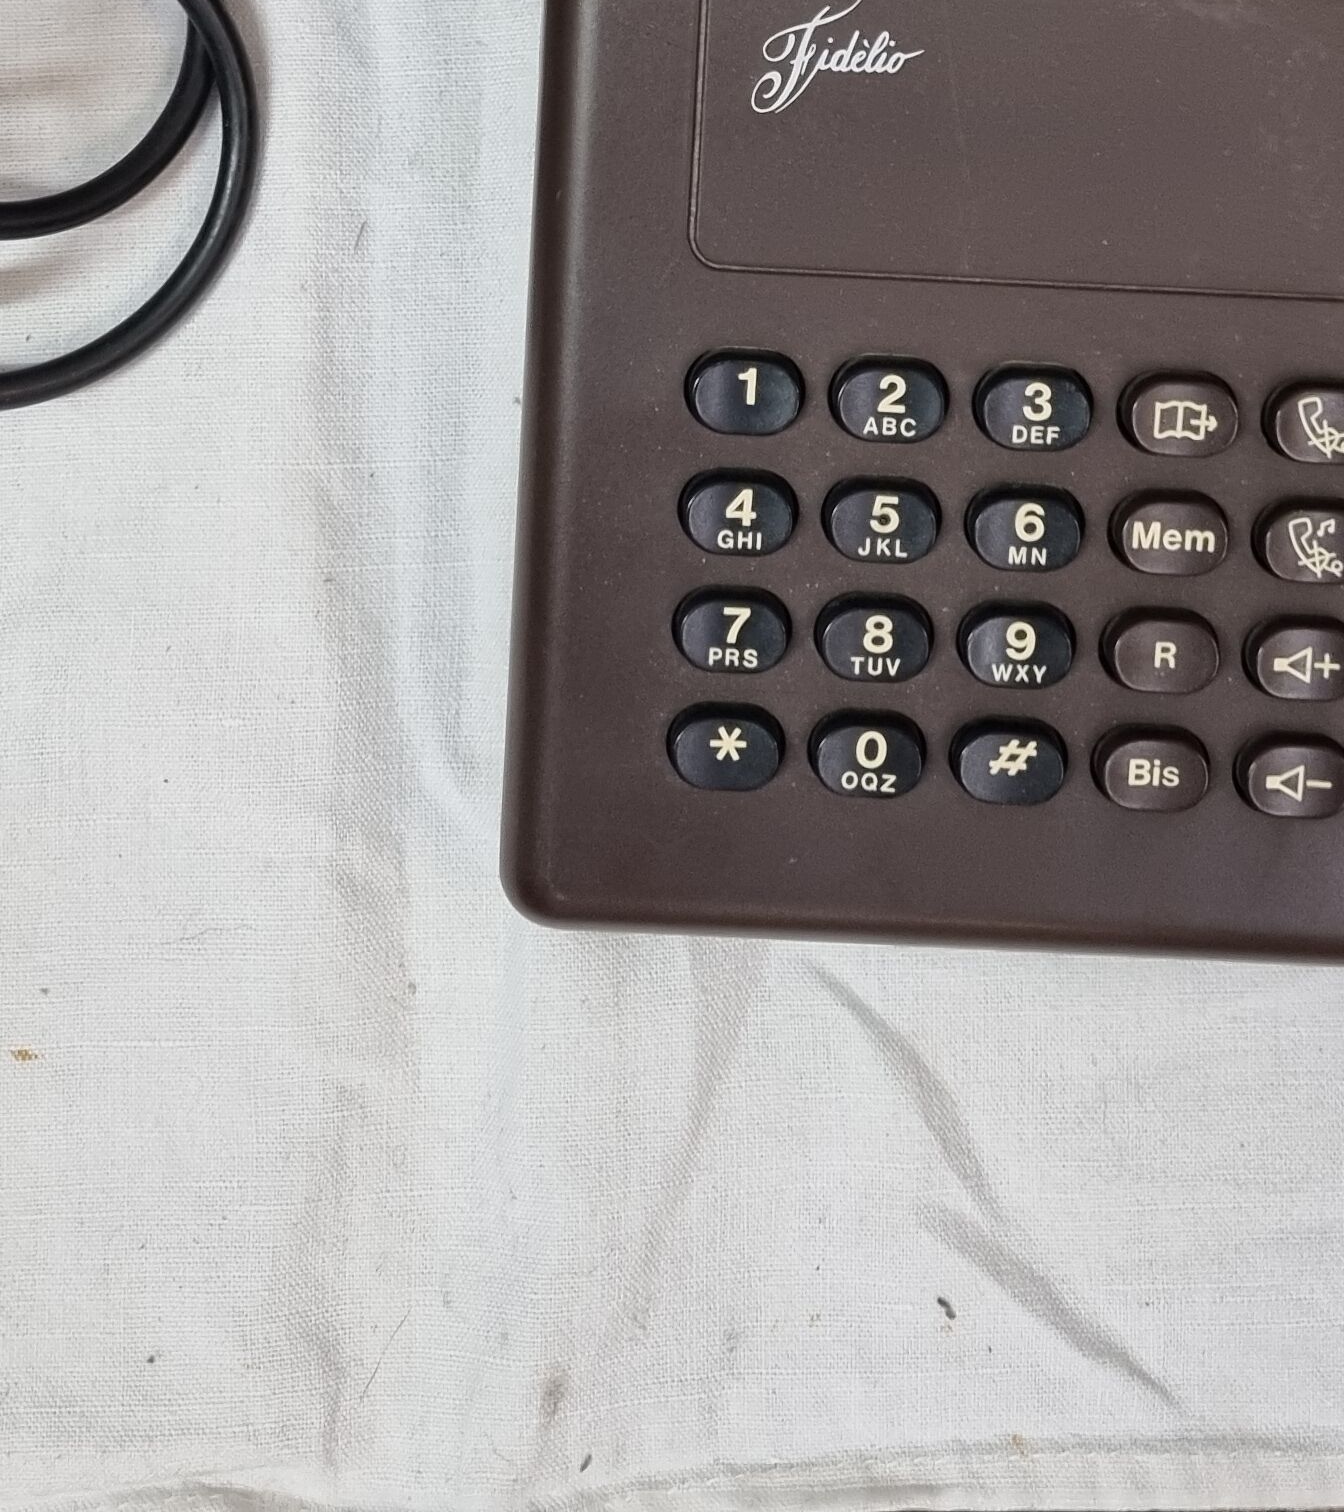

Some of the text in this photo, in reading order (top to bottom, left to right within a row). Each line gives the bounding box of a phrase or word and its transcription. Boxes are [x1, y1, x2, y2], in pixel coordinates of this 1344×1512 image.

[737, 367, 758, 406] 1
[876, 374, 907, 414] 2
[1021, 382, 1052, 422] 3
[862, 416, 917, 438] ABC
[1011, 424, 1061, 445] DEF
[725, 488, 757, 527] 4
[869, 495, 900, 534] 5
[1014, 502, 1045, 542] 6
[717, 529, 762, 551] GHI
[858, 537, 908, 558] JKL
[1131, 521, 1216, 553] Mem
[1007, 545, 1047, 566] MN
[723, 606, 752, 644] 7
[862, 614, 894, 654] 8
[1005, 621, 1036, 661] 9
[1154, 641, 1177, 669] R
[708, 646, 758, 668] PRS
[850, 656, 901, 677] TUV
[991, 663, 1047, 684] WXY
[840, 771, 897, 793] OQZ
[1127, 758, 1180, 787] Bis
